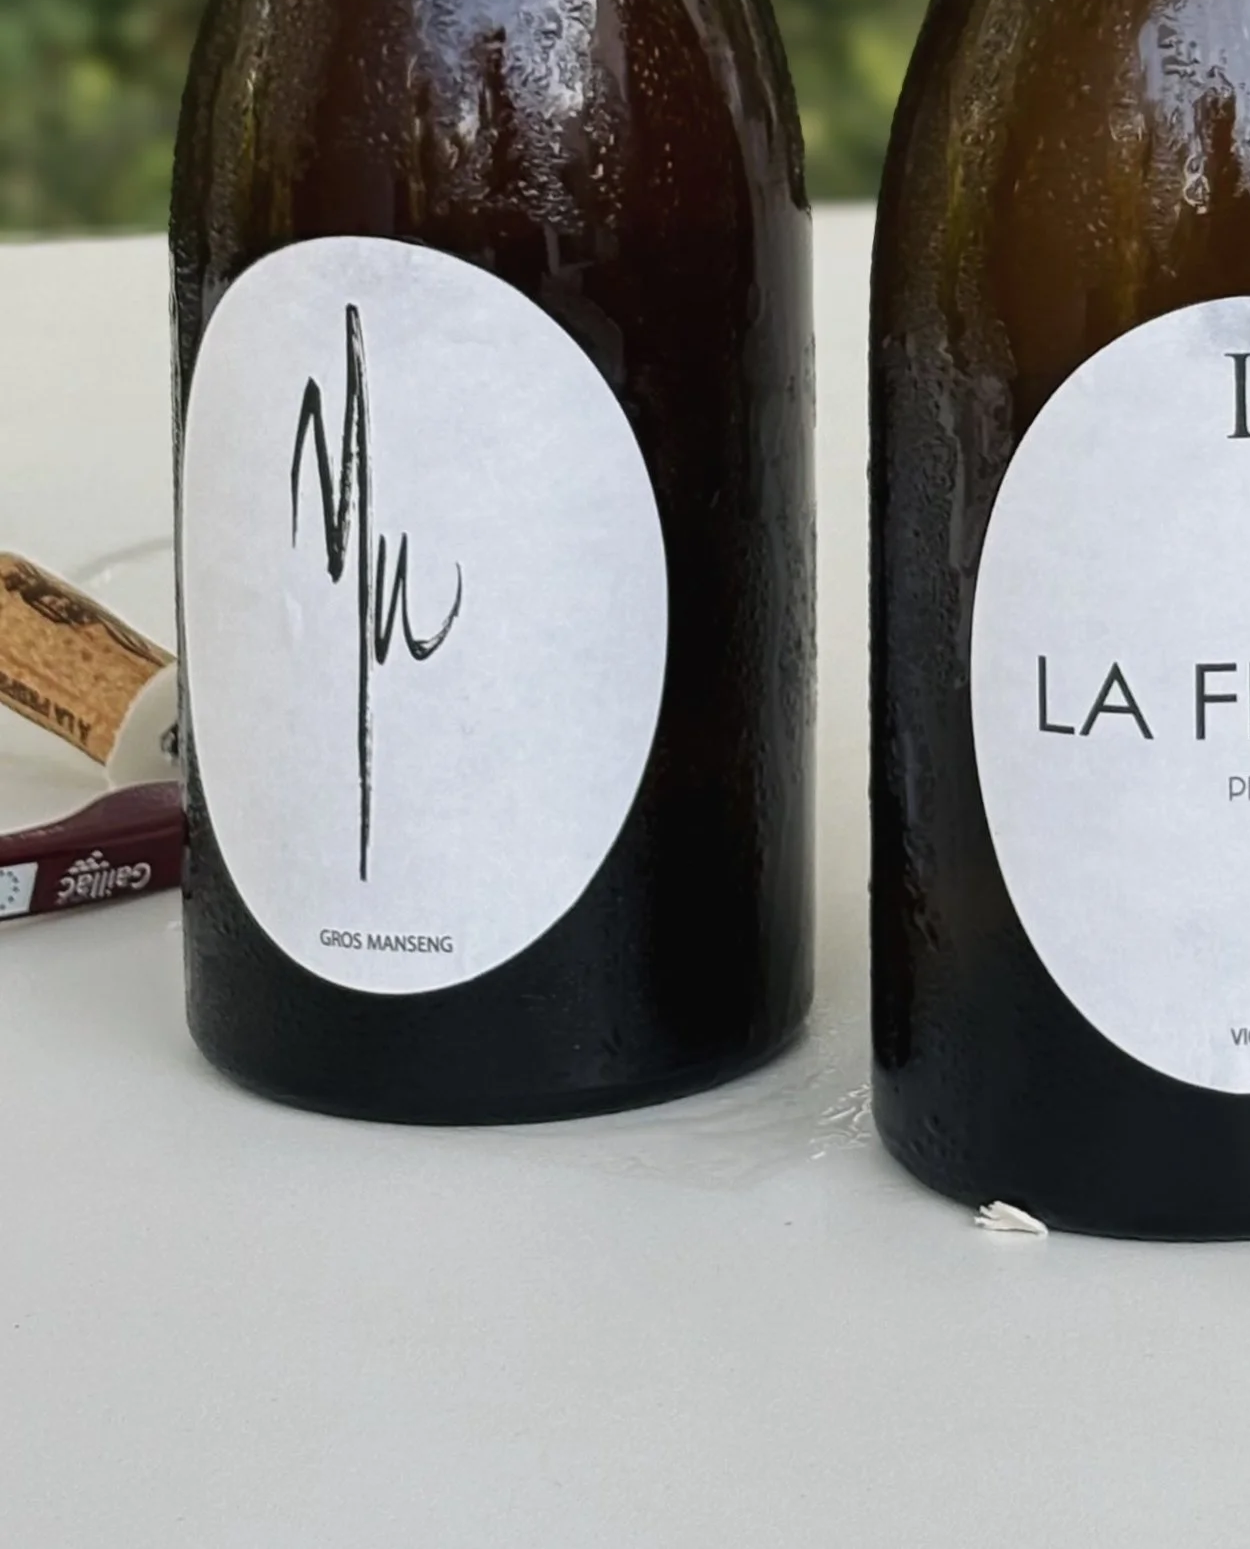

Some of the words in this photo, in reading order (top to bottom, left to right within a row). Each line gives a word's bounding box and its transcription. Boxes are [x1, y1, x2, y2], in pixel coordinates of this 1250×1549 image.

[1037, 654, 1155, 741] LA
[58, 861, 152, 900] Gaillac
[319, 928, 363, 950] GROS
[366, 933, 454, 953] MANSENG
